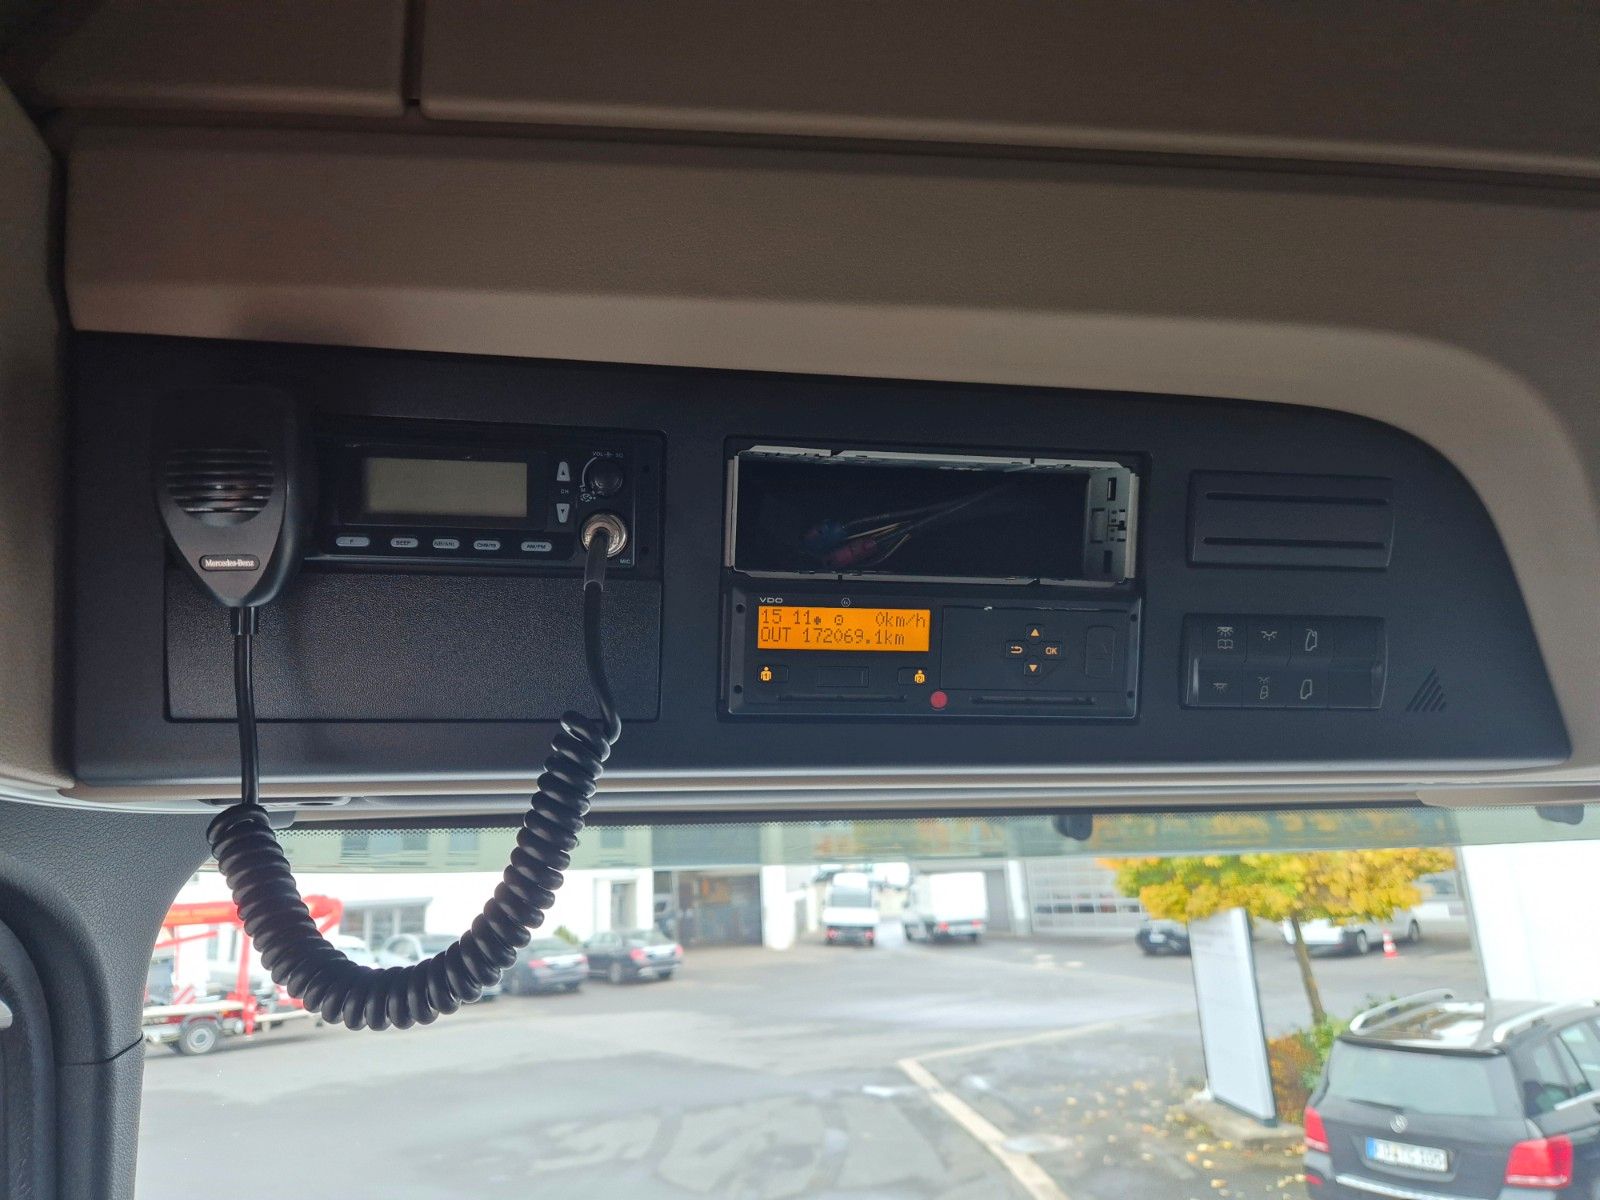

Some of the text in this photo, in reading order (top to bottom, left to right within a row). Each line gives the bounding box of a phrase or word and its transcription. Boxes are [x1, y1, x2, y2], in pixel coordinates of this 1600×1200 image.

[205, 558, 255, 568] Mercedes-Benz
[762, 608, 782, 624] 15
[875, 612, 926, 628] 0km/h
[760, 626, 905, 645] OUT 172069.1km
[1045, 646, 1058, 655] OK
